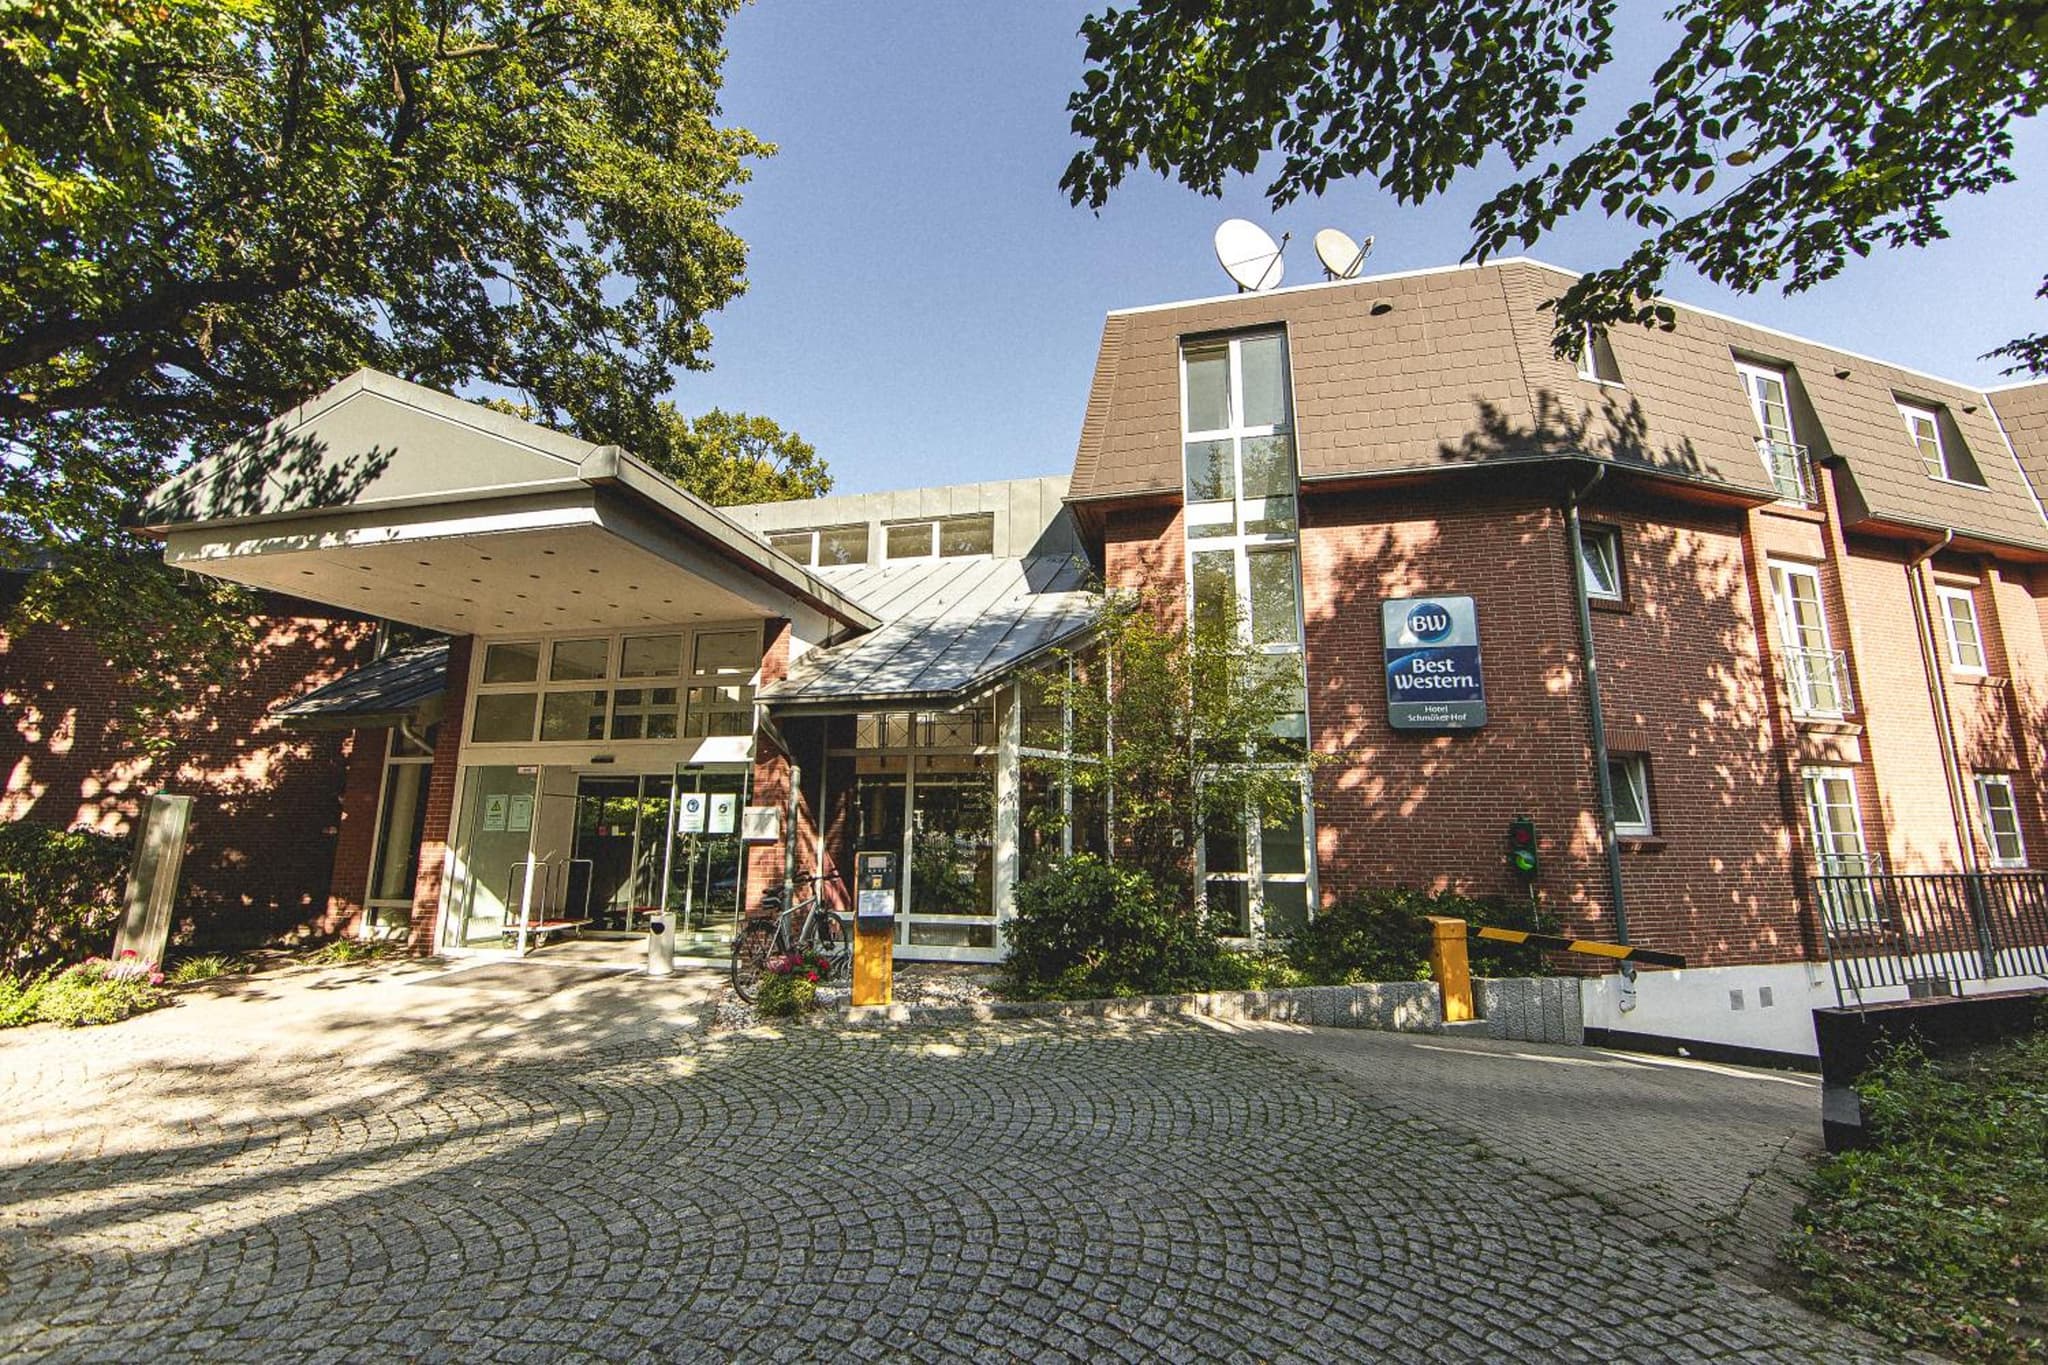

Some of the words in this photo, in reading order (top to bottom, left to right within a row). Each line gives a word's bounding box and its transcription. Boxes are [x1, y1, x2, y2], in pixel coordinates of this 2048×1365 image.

[1412, 615, 1447, 632] BW
[1412, 658, 1456, 674] Best
[1424, 705, 1449, 713] Hotel
